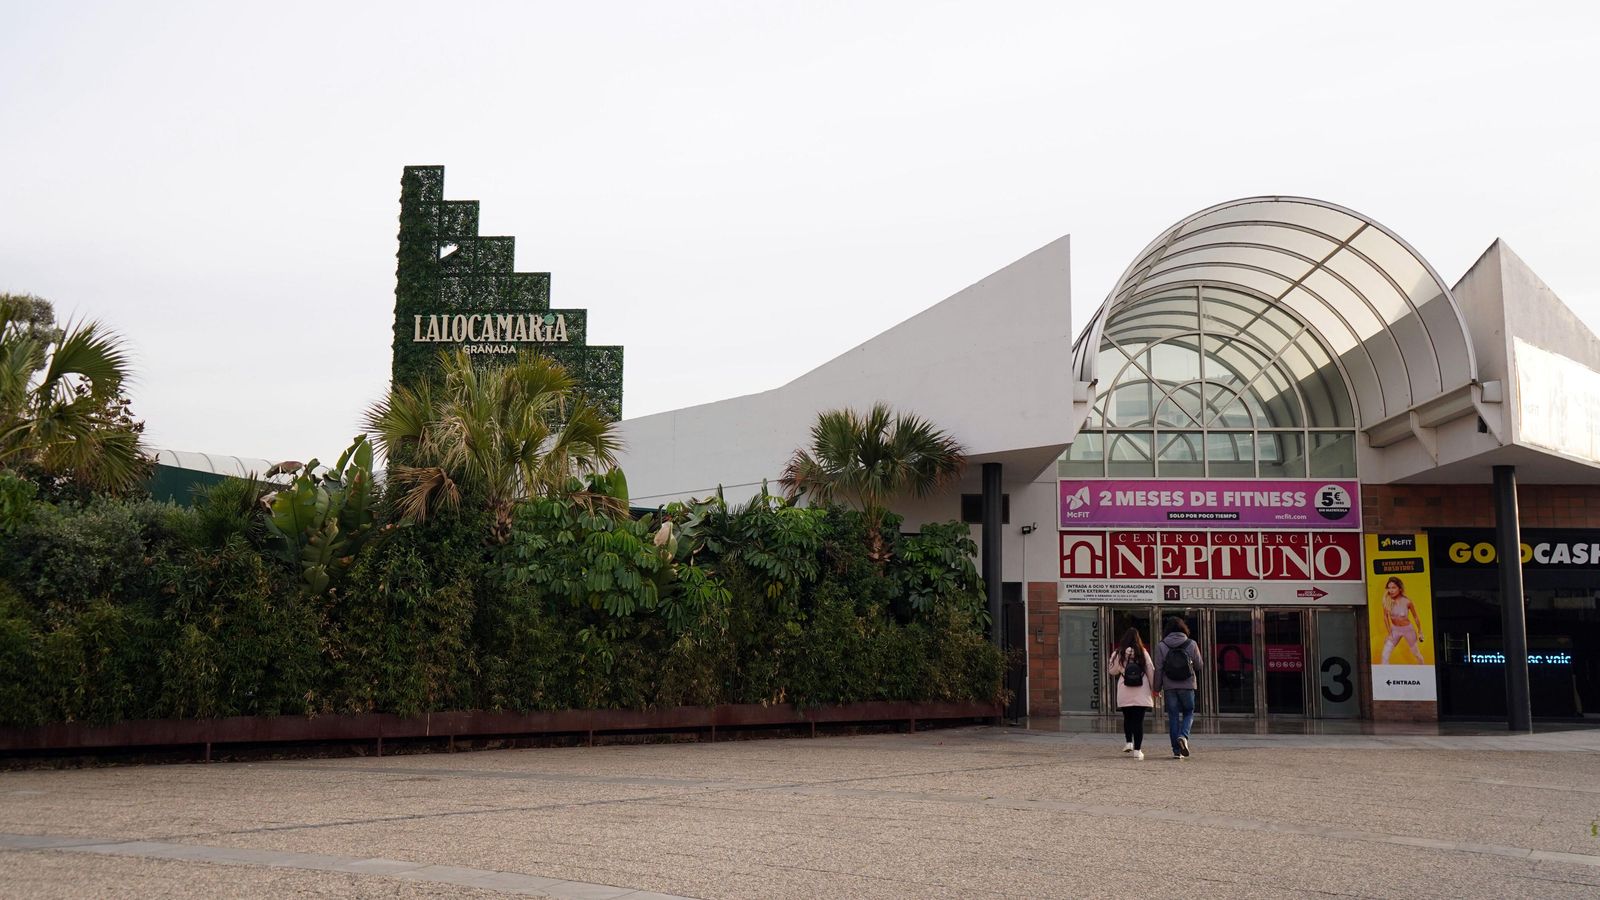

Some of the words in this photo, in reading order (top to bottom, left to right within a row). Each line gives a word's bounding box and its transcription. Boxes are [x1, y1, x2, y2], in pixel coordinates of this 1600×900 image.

[462, 344, 517, 354] GRANADA
[1099, 490, 1112, 506] 2
[1115, 490, 1184, 507] MESES
[1190, 491, 1217, 507] DE
[1223, 491, 1307, 507] FITNESS
[1118, 533, 1200, 543] CENTRO
[1214, 534, 1337, 544] COMERCIAL
[1114, 543, 1351, 578] NEPTUNO
[1182, 586, 1241, 600] PUERTA
[1089, 621, 1099, 710] Bienvenidos
[1321, 656, 1353, 703] 3
